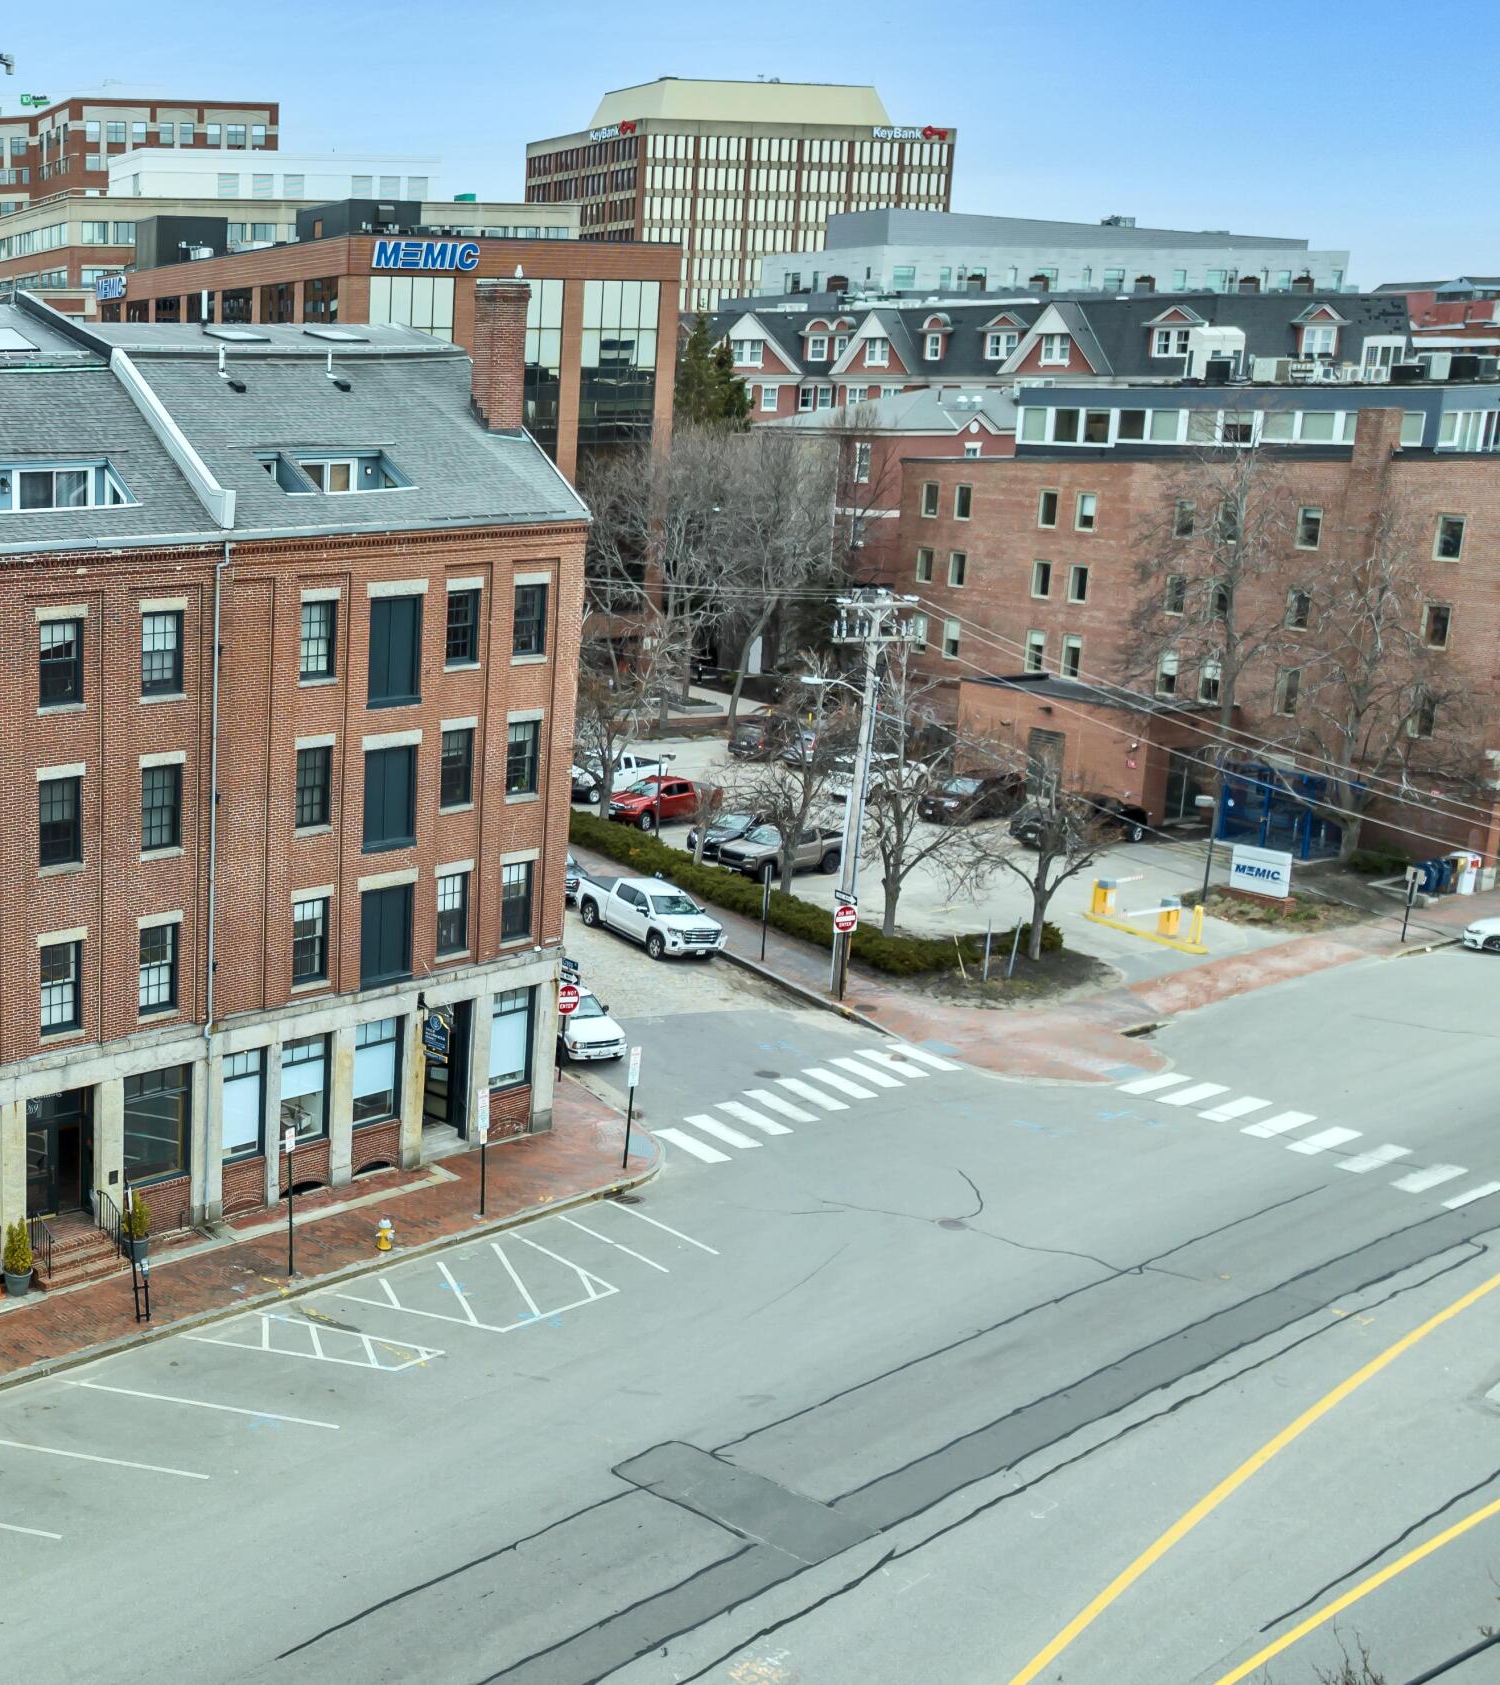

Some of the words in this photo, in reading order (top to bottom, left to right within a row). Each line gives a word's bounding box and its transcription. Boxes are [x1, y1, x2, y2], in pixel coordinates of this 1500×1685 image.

[590, 126, 619, 142] KeyBank
[872, 127, 921, 140] KeyBank
[372, 240, 480, 271] MEMIC
[1235, 864, 1280, 880] MEMIC
